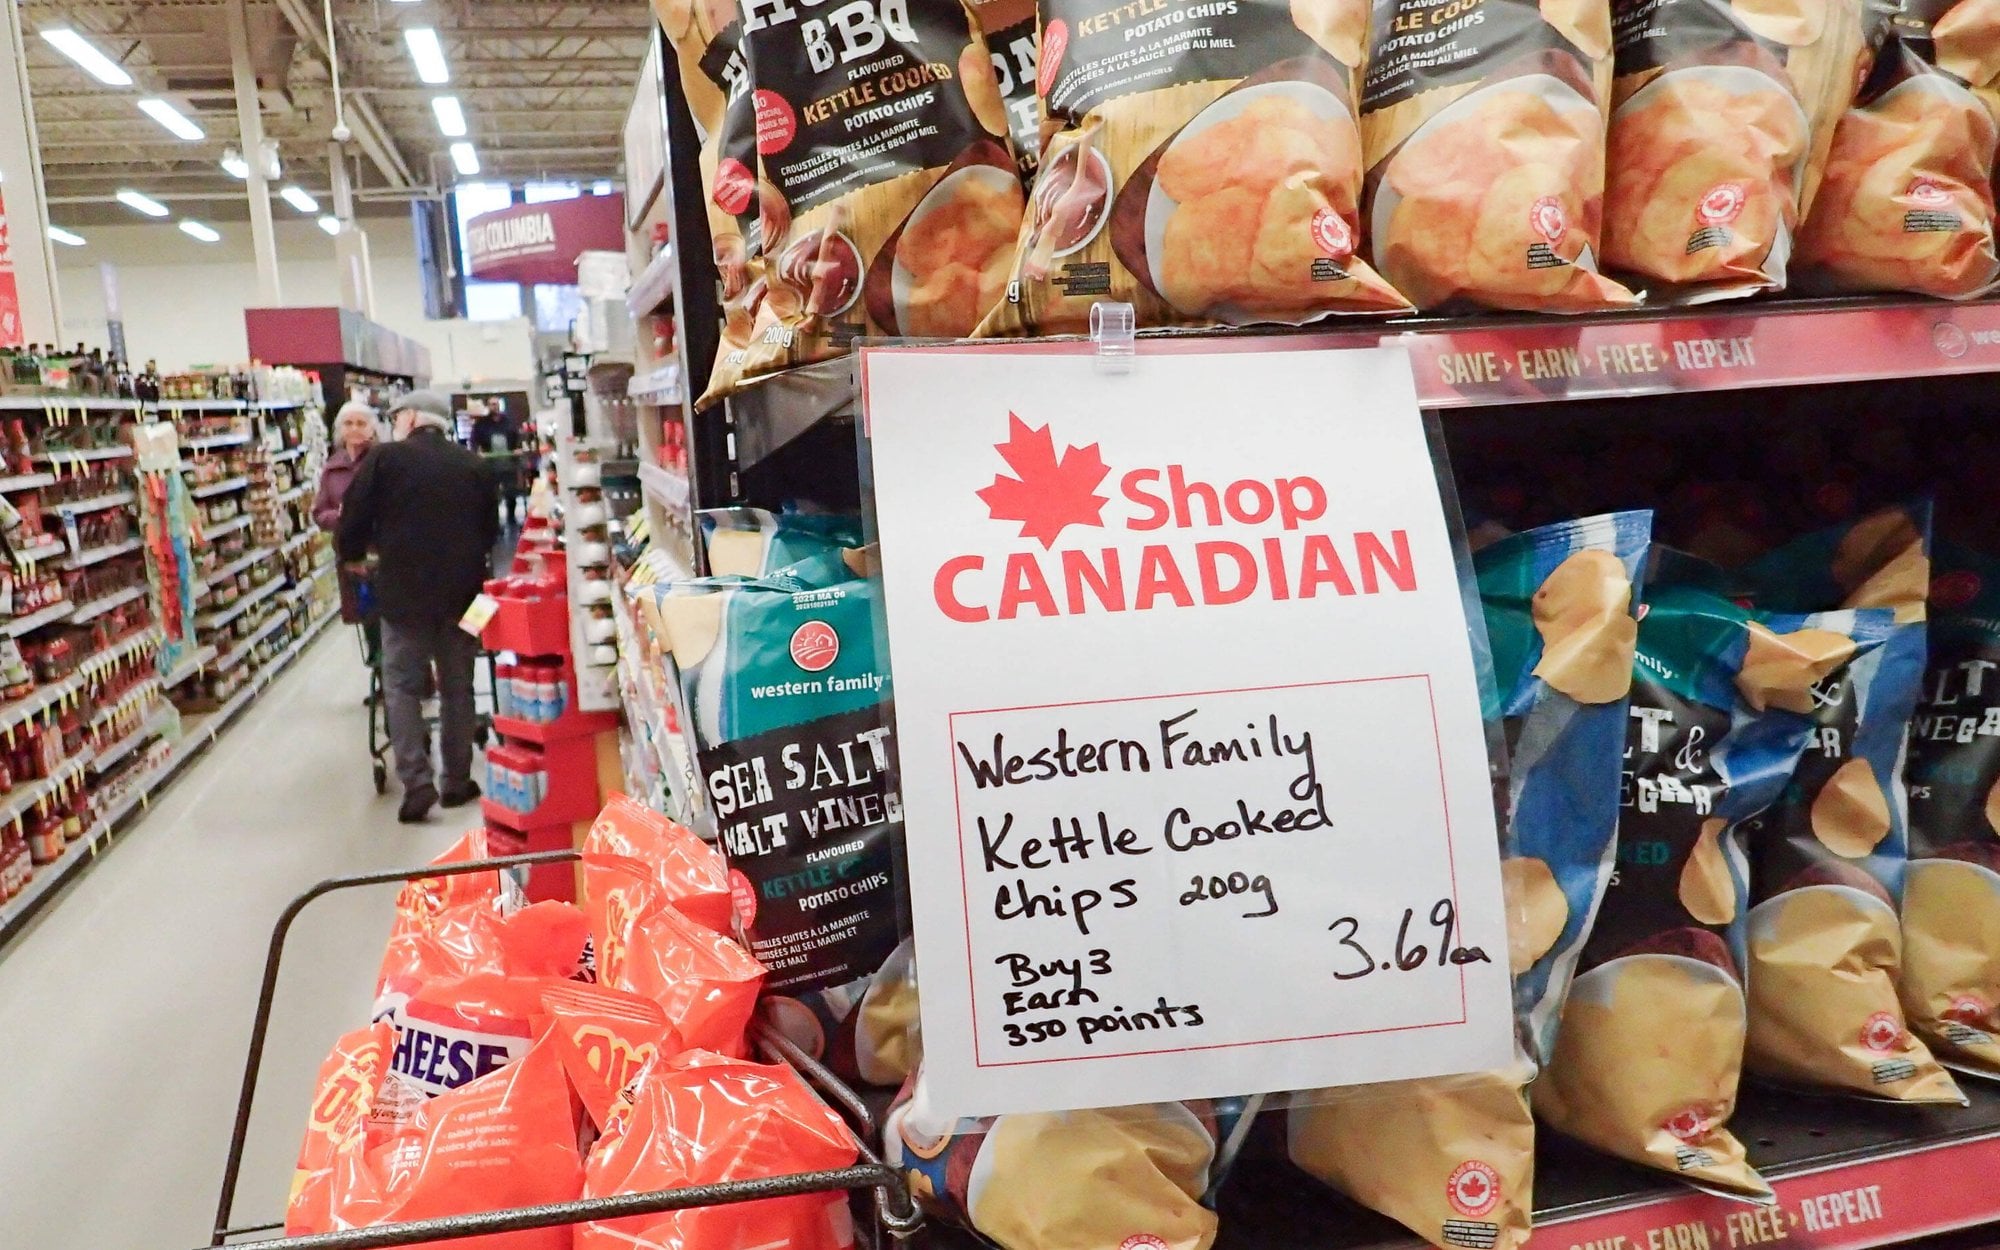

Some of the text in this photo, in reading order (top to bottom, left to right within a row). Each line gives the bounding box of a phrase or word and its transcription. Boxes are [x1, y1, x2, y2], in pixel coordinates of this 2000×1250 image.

[800, 0, 919, 74] BBQ
[1124, 0, 1238, 42] POTATO CHIPS
[1378, 10, 1485, 56] POTATO CHIPS
[1101, 50, 1136, 65] CUITES
[1148, 42, 1161, 51] LA
[1163, 27, 1213, 45] MARMITE
[1116, 61, 1130, 71] LA
[1132, 52, 1165, 66] SAUCE
[1167, 42, 1191, 56] BBQ
[1192, 39, 1208, 49] AU
[1209, 38, 1236, 49] MIEL
[1367, 77, 1379, 87] LA
[1380, 62, 1410, 82] SAUCE
[1437, 56, 1451, 65] AU
[1453, 47, 1479, 60] MIEL
[1396, 54, 1409, 64] LA
[1410, 41, 1458, 60] MARMITE
[847, 55, 904, 81] FLAVOURED
[802, 81, 876, 126] KETTLE
[880, 63, 952, 96] COOKED
[843, 91, 935, 132] POTATO CHIPS
[781, 150, 832, 177] CROUSTILLES
[833, 141, 861, 158] CUITES
[870, 132, 881, 144] LA
[881, 118, 920, 140] MARMITE
[784, 158, 839, 187] AROMATISÉES
[848, 151, 859, 162] LA
[859, 143, 887, 159] SAUCE
[888, 137, 905, 150] BBQ
[906, 132, 918, 144] AU
[919, 125, 939, 138] MIEL
[486, 213, 554, 252] COLUMBIA
[763, 326, 793, 348] 200 g
[1438, 337, 1757, 385] SAVE EARN FREE REPEAT
[1120, 464, 1328, 531] Shop
[933, 530, 1417, 623] CANADIAN
[751, 672, 883, 699] western family
[1634, 650, 1673, 678] mily
[958, 708, 1317, 799] Western Family
[1674, 725, 1705, 774] &
[709, 726, 891, 819] SEA SALT
[1620, 771, 1712, 815] EGAR
[723, 792, 904, 857] MALT VINEG
[977, 783, 1333, 872] Kettle Cooked
[806, 840, 865, 864] FLAVOURED
[762, 865, 833, 899] KETTLE
[799, 872, 888, 912] POTATO CHIPS
[1179, 871, 1279, 918] 200g
[782, 931, 810, 945] CUITES
[818, 926, 830, 936] LA
[829, 910, 870, 931] MARMITE
[789, 944, 801, 954] AU
[801, 940, 817, 951] SEL
[817, 930, 847, 948] MARIN
[847, 927, 857, 937] ET
[1328, 898, 1454, 980] 3.69
[775, 959, 787, 969] DE
[787, 954, 808, 967] MALT
[995, 949, 1112, 990] Buy 3
[1003, 988, 1099, 1016] Earn
[1003, 996, 1204, 1046] 350 points
[373, 1008, 510, 1090] HEESE
[1727, 1184, 1882, 1246] FREE REPEAT
